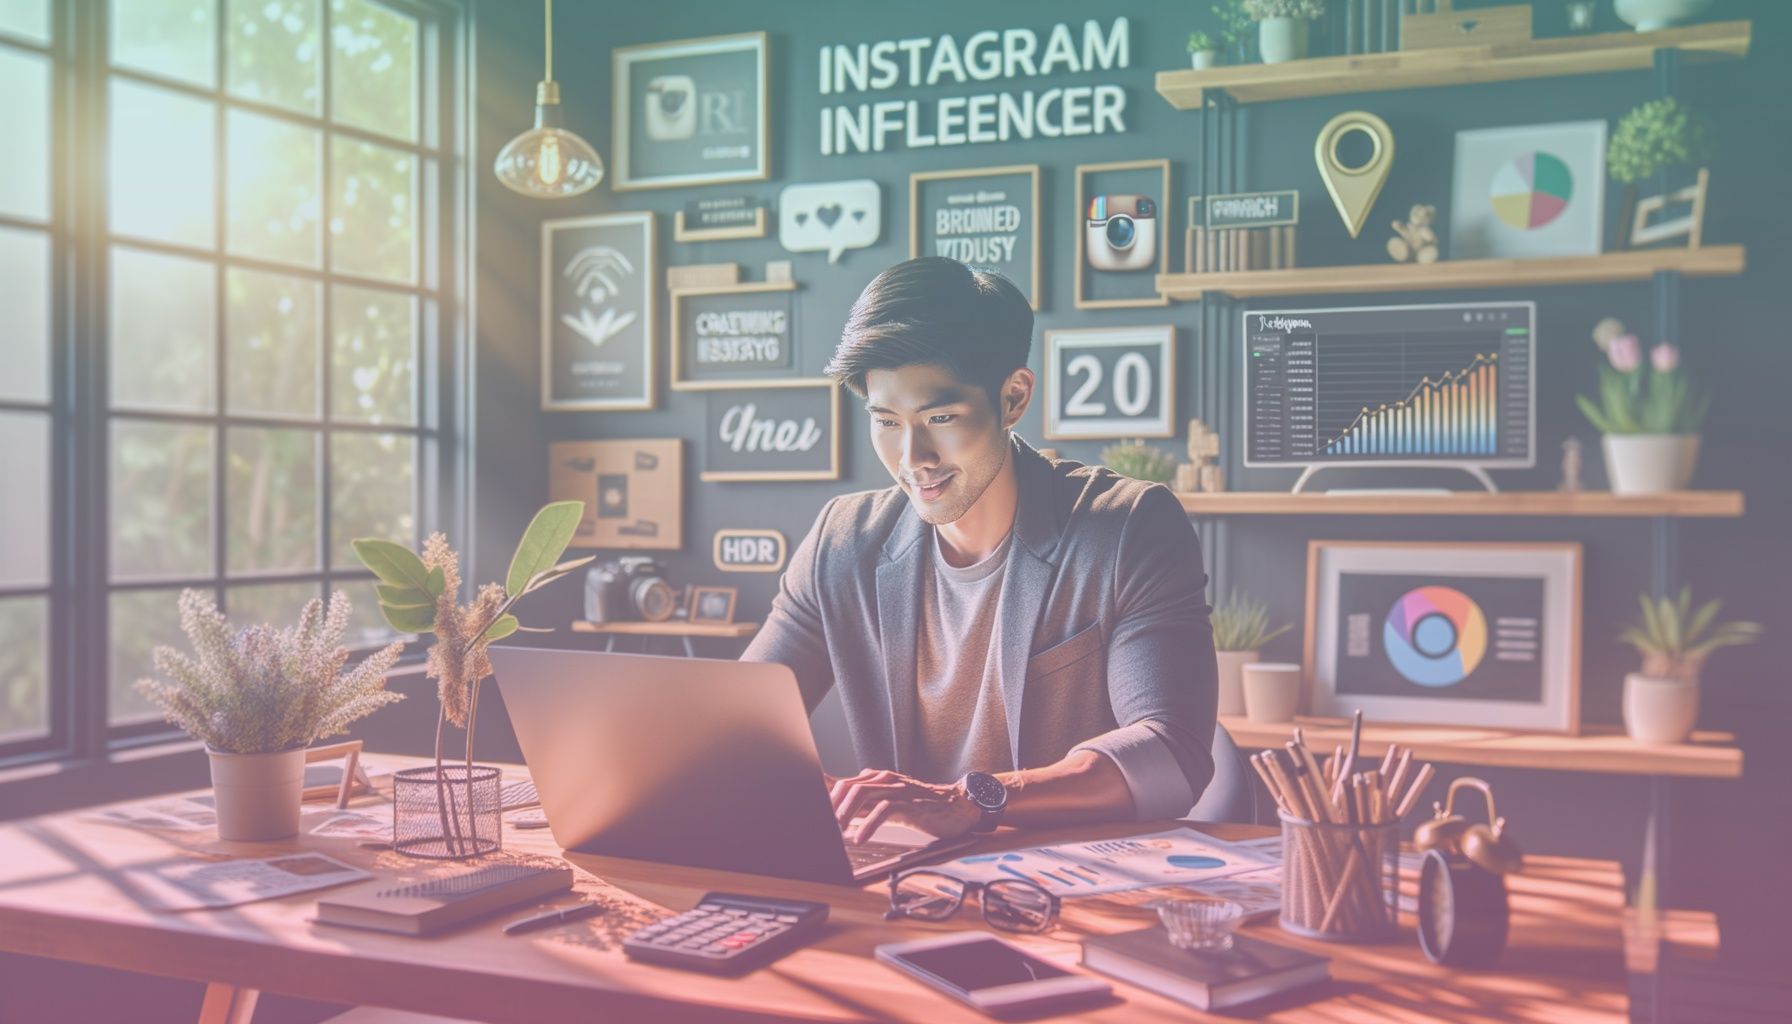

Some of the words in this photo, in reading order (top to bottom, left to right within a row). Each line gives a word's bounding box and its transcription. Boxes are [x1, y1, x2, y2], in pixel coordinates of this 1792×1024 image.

[819, 16, 1129, 94] INSTAGRAM
[820, 85, 1126, 155] INFLEENCER
[1065, 352, 1152, 416] 20
[722, 538, 775, 562] HDR
